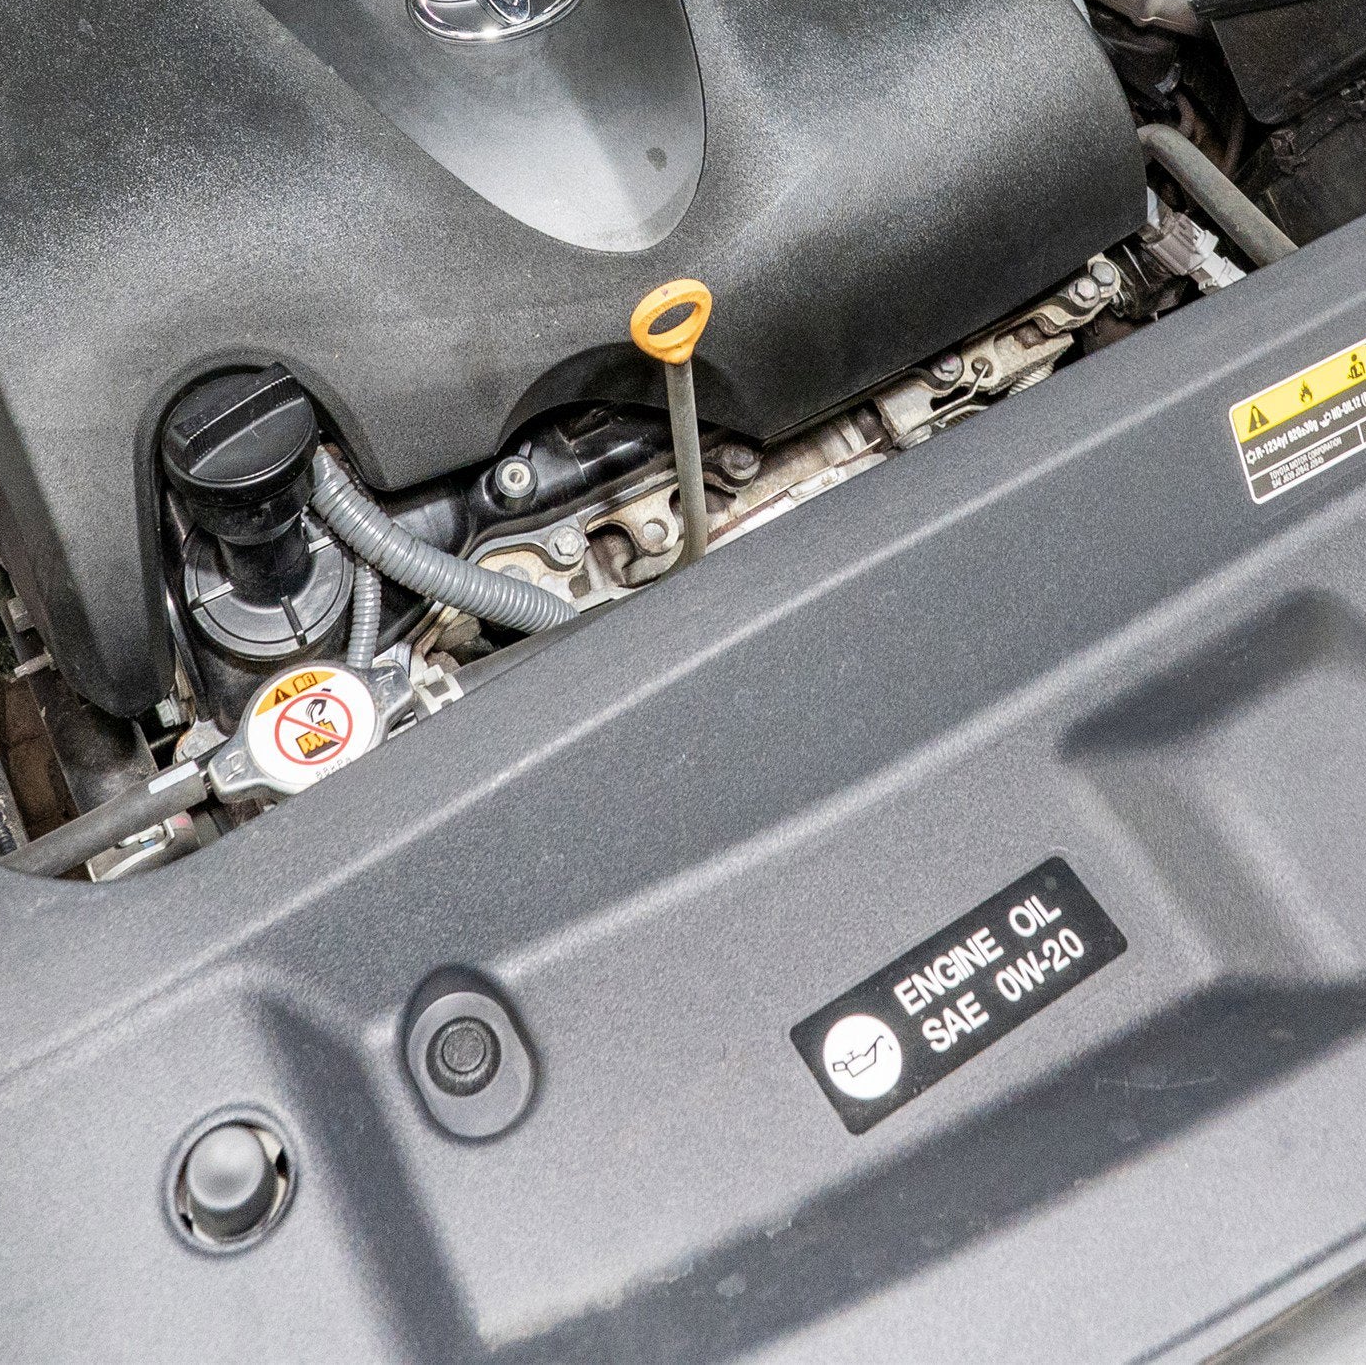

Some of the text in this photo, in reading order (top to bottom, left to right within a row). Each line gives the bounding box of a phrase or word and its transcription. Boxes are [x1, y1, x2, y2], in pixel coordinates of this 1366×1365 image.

[1255, 433, 1288, 459] R-1234yf
[893, 895, 1062, 1016] ENGINE OIL
[922, 928, 1085, 1053] SAE 0W-20
